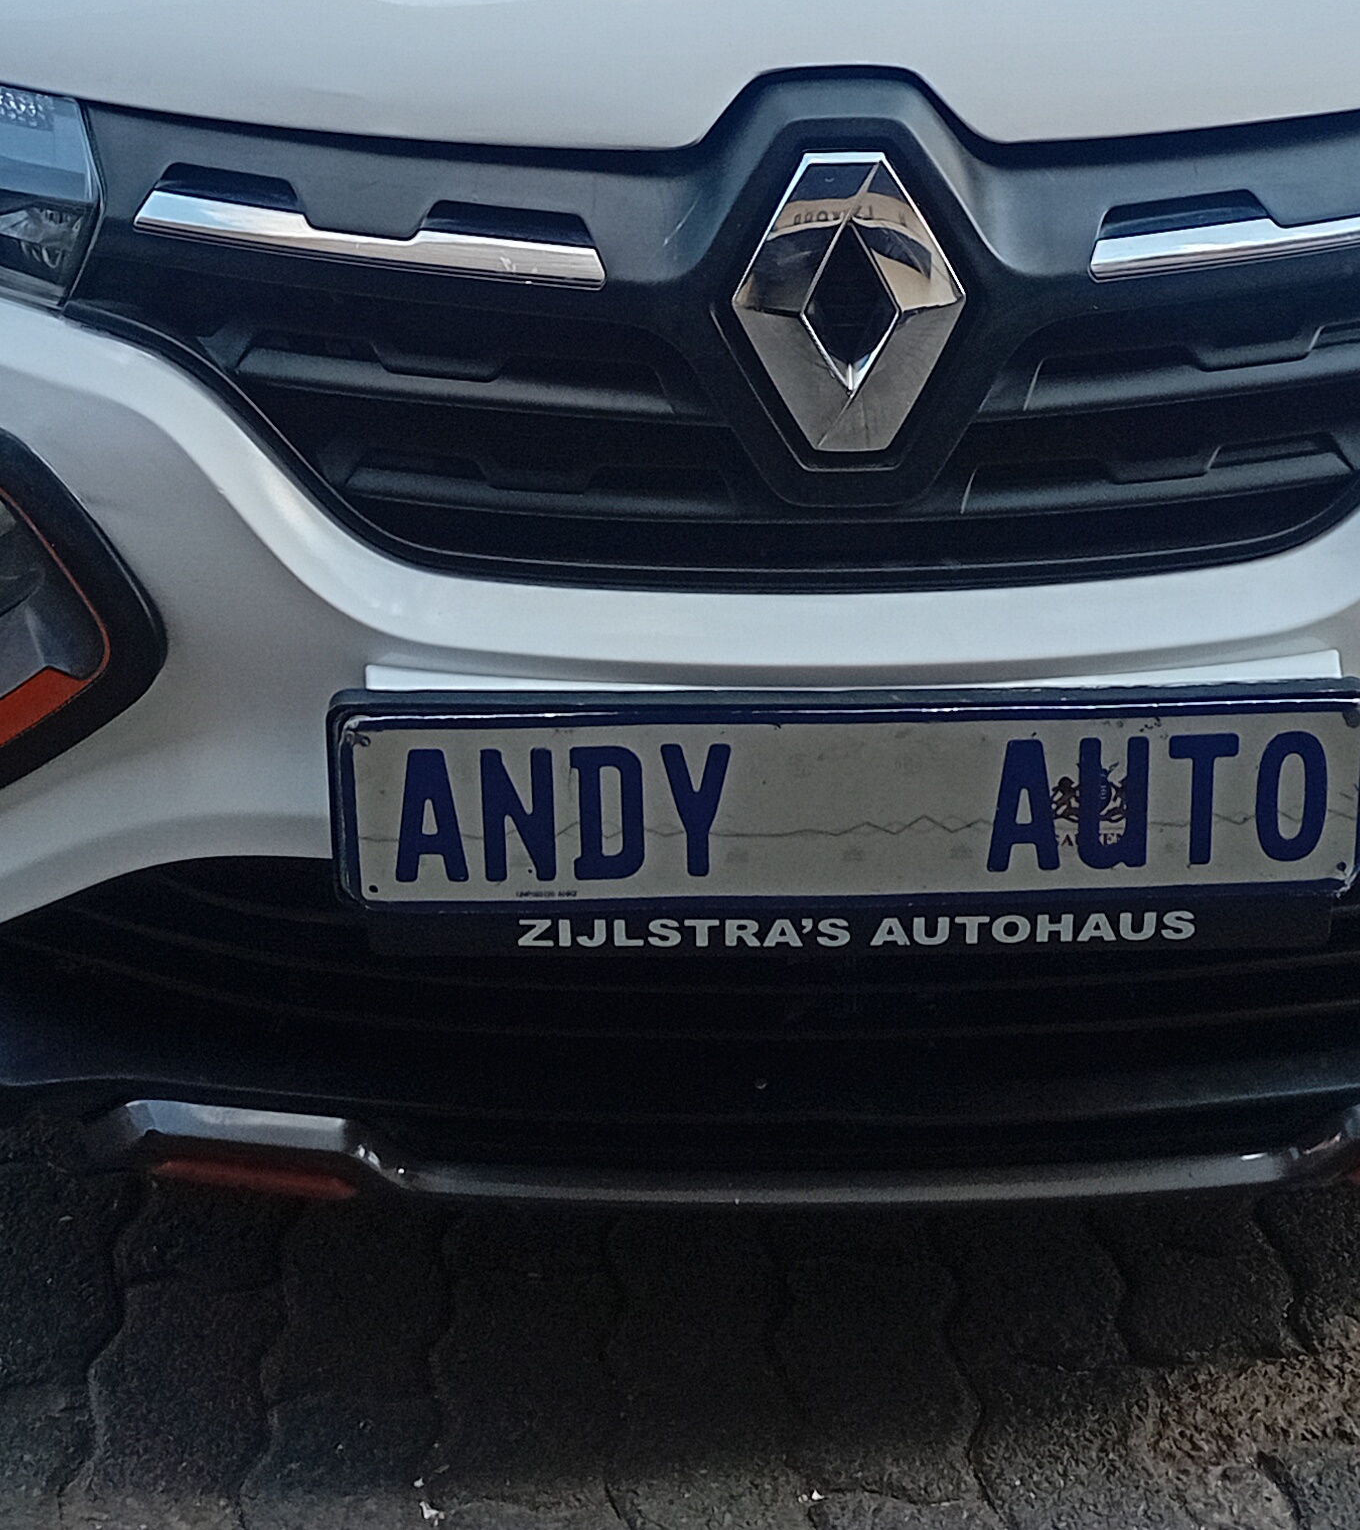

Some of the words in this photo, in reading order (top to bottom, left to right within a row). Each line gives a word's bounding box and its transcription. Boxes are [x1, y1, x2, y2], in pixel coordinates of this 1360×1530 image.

[395, 743, 731, 883] ANDY
[986, 730, 1328, 872] AUTO
[517, 917, 852, 948] ZIJLSTRA'S
[870, 910, 1197, 947] AUTOHAUS
